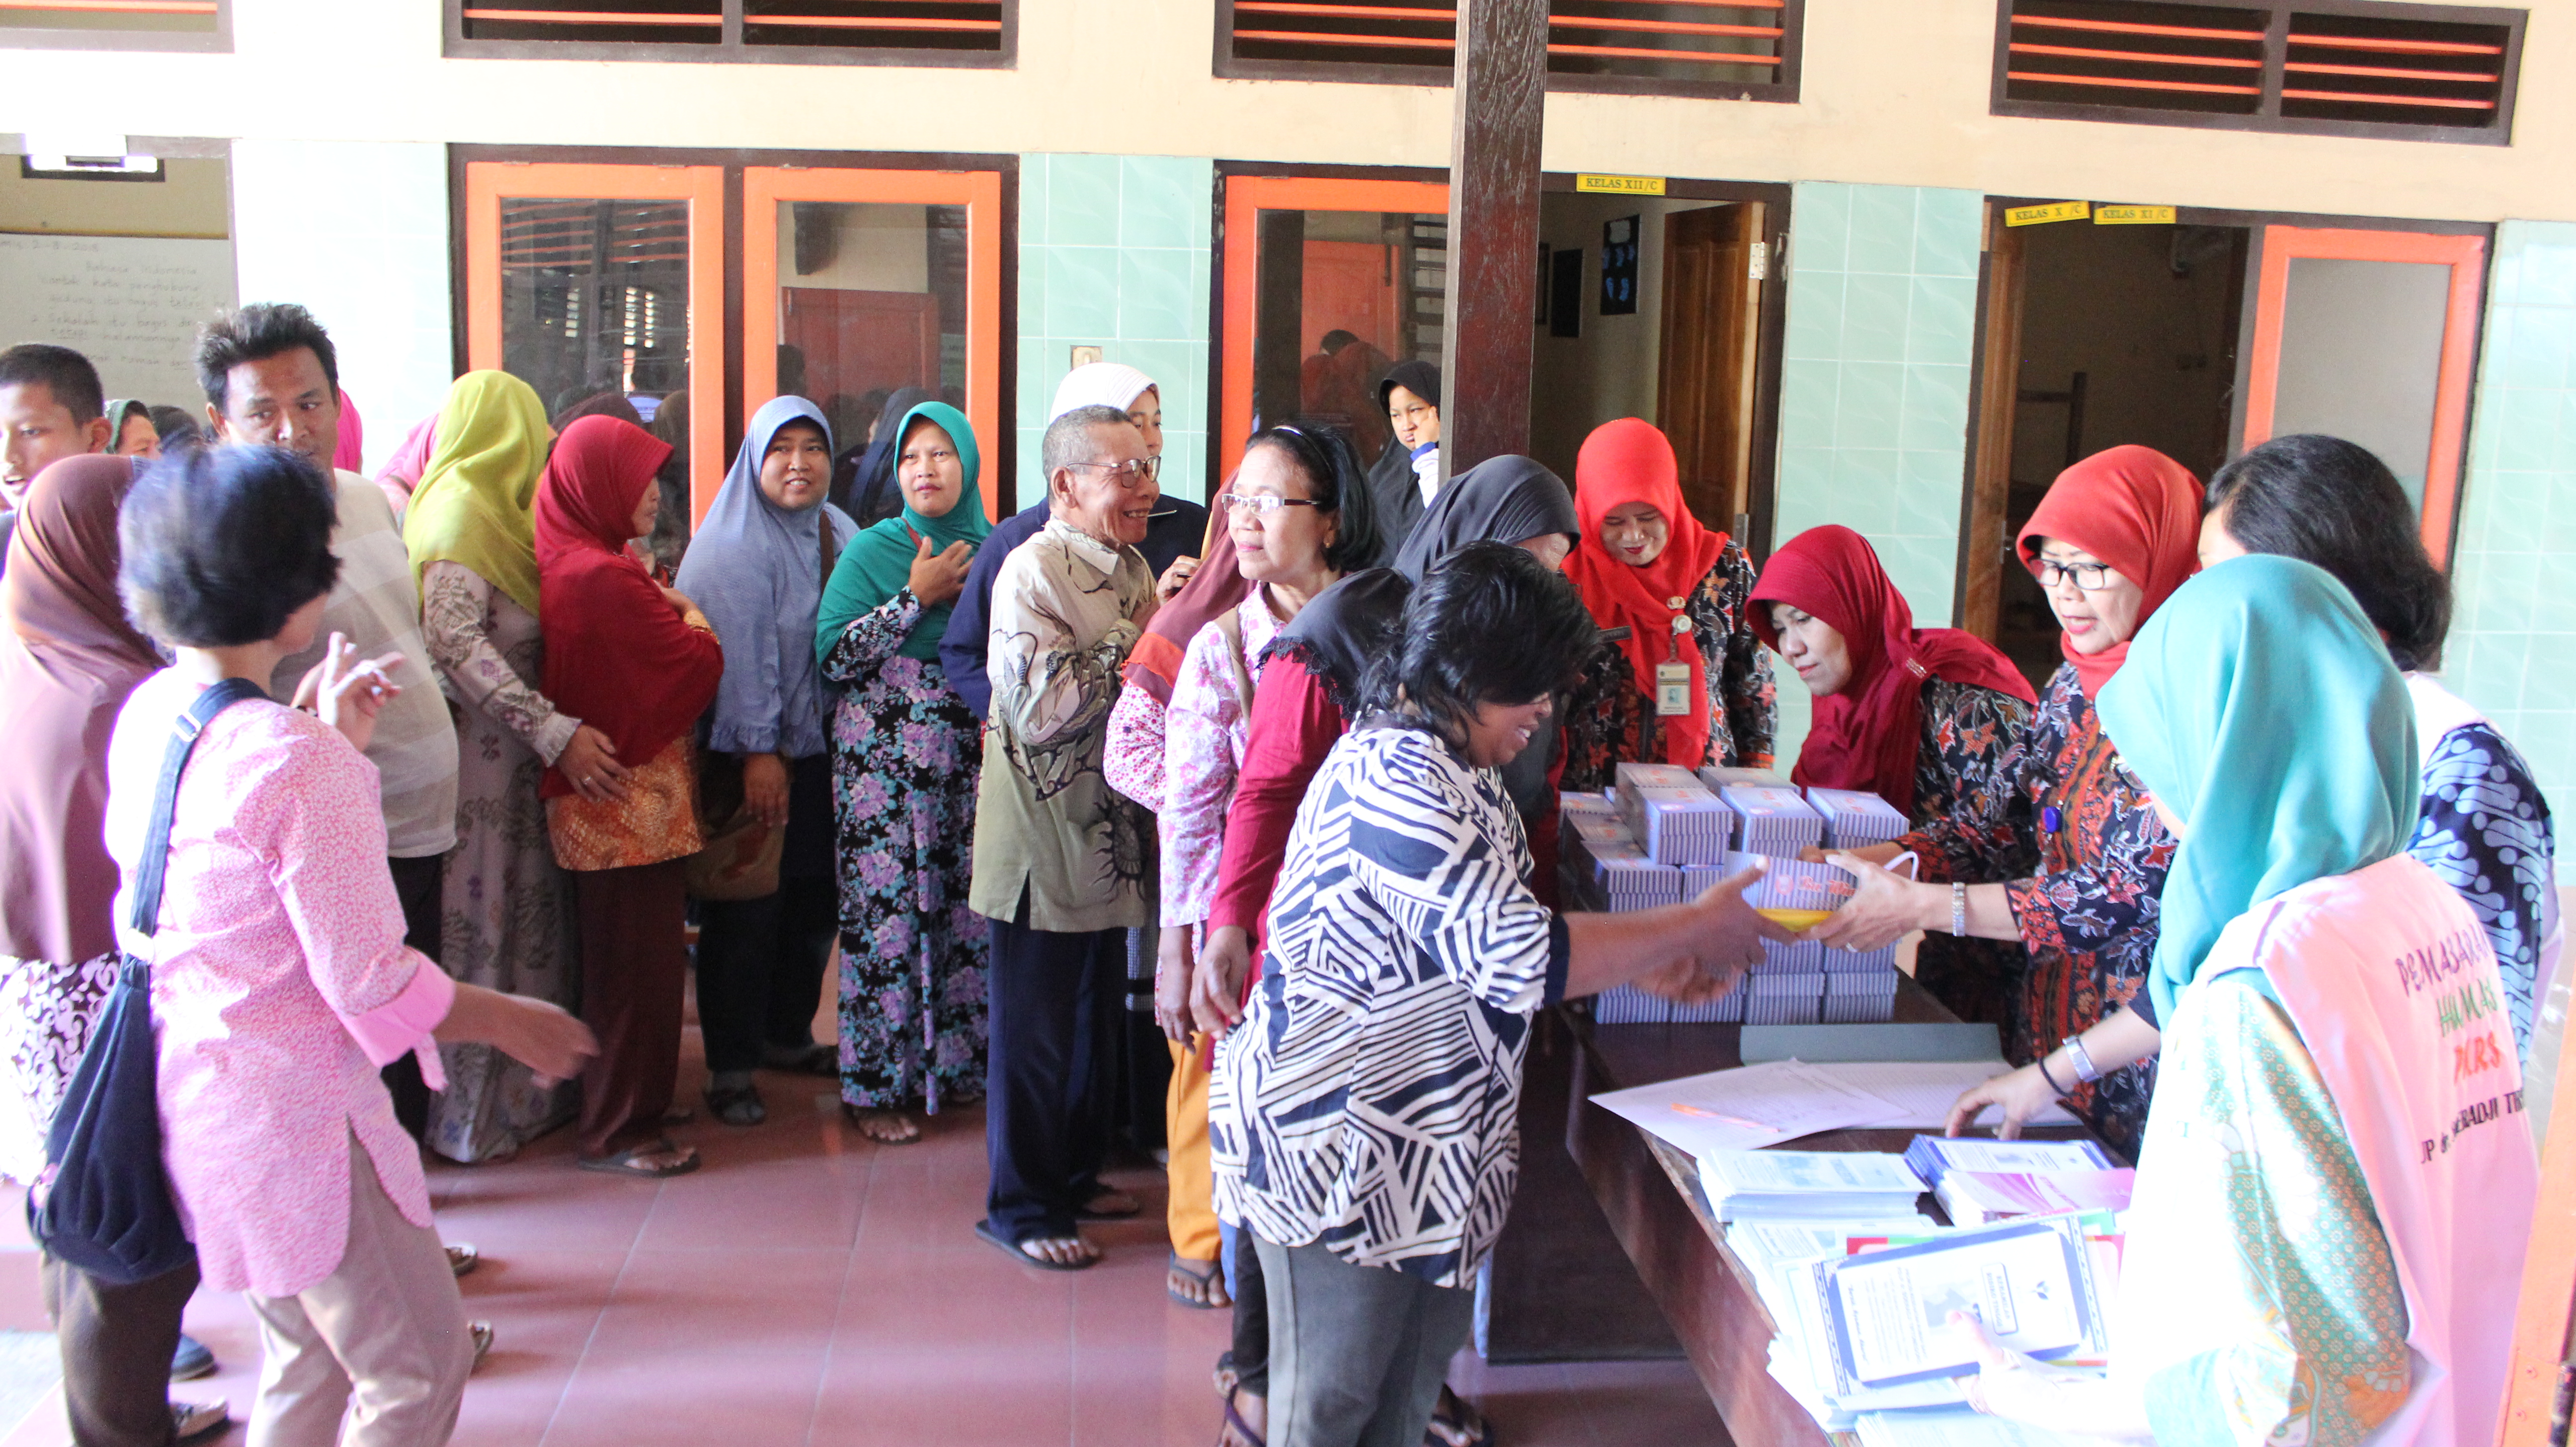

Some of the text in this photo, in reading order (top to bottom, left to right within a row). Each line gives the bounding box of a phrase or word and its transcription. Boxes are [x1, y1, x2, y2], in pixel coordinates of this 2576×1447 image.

[1586, 178, 1621, 188] KELAS
[1625, 180, 1643, 189] XII
[2015, 208, 2048, 221] KELAS
[2055, 208, 2062, 216] X
[2103, 210, 2136, 219] KELAS
[2141, 210, 2153, 219] XI
[2436, 975, 2499, 1038] HUMAS
[1986, 1272, 2003, 1328] RISIKO TINGGI
